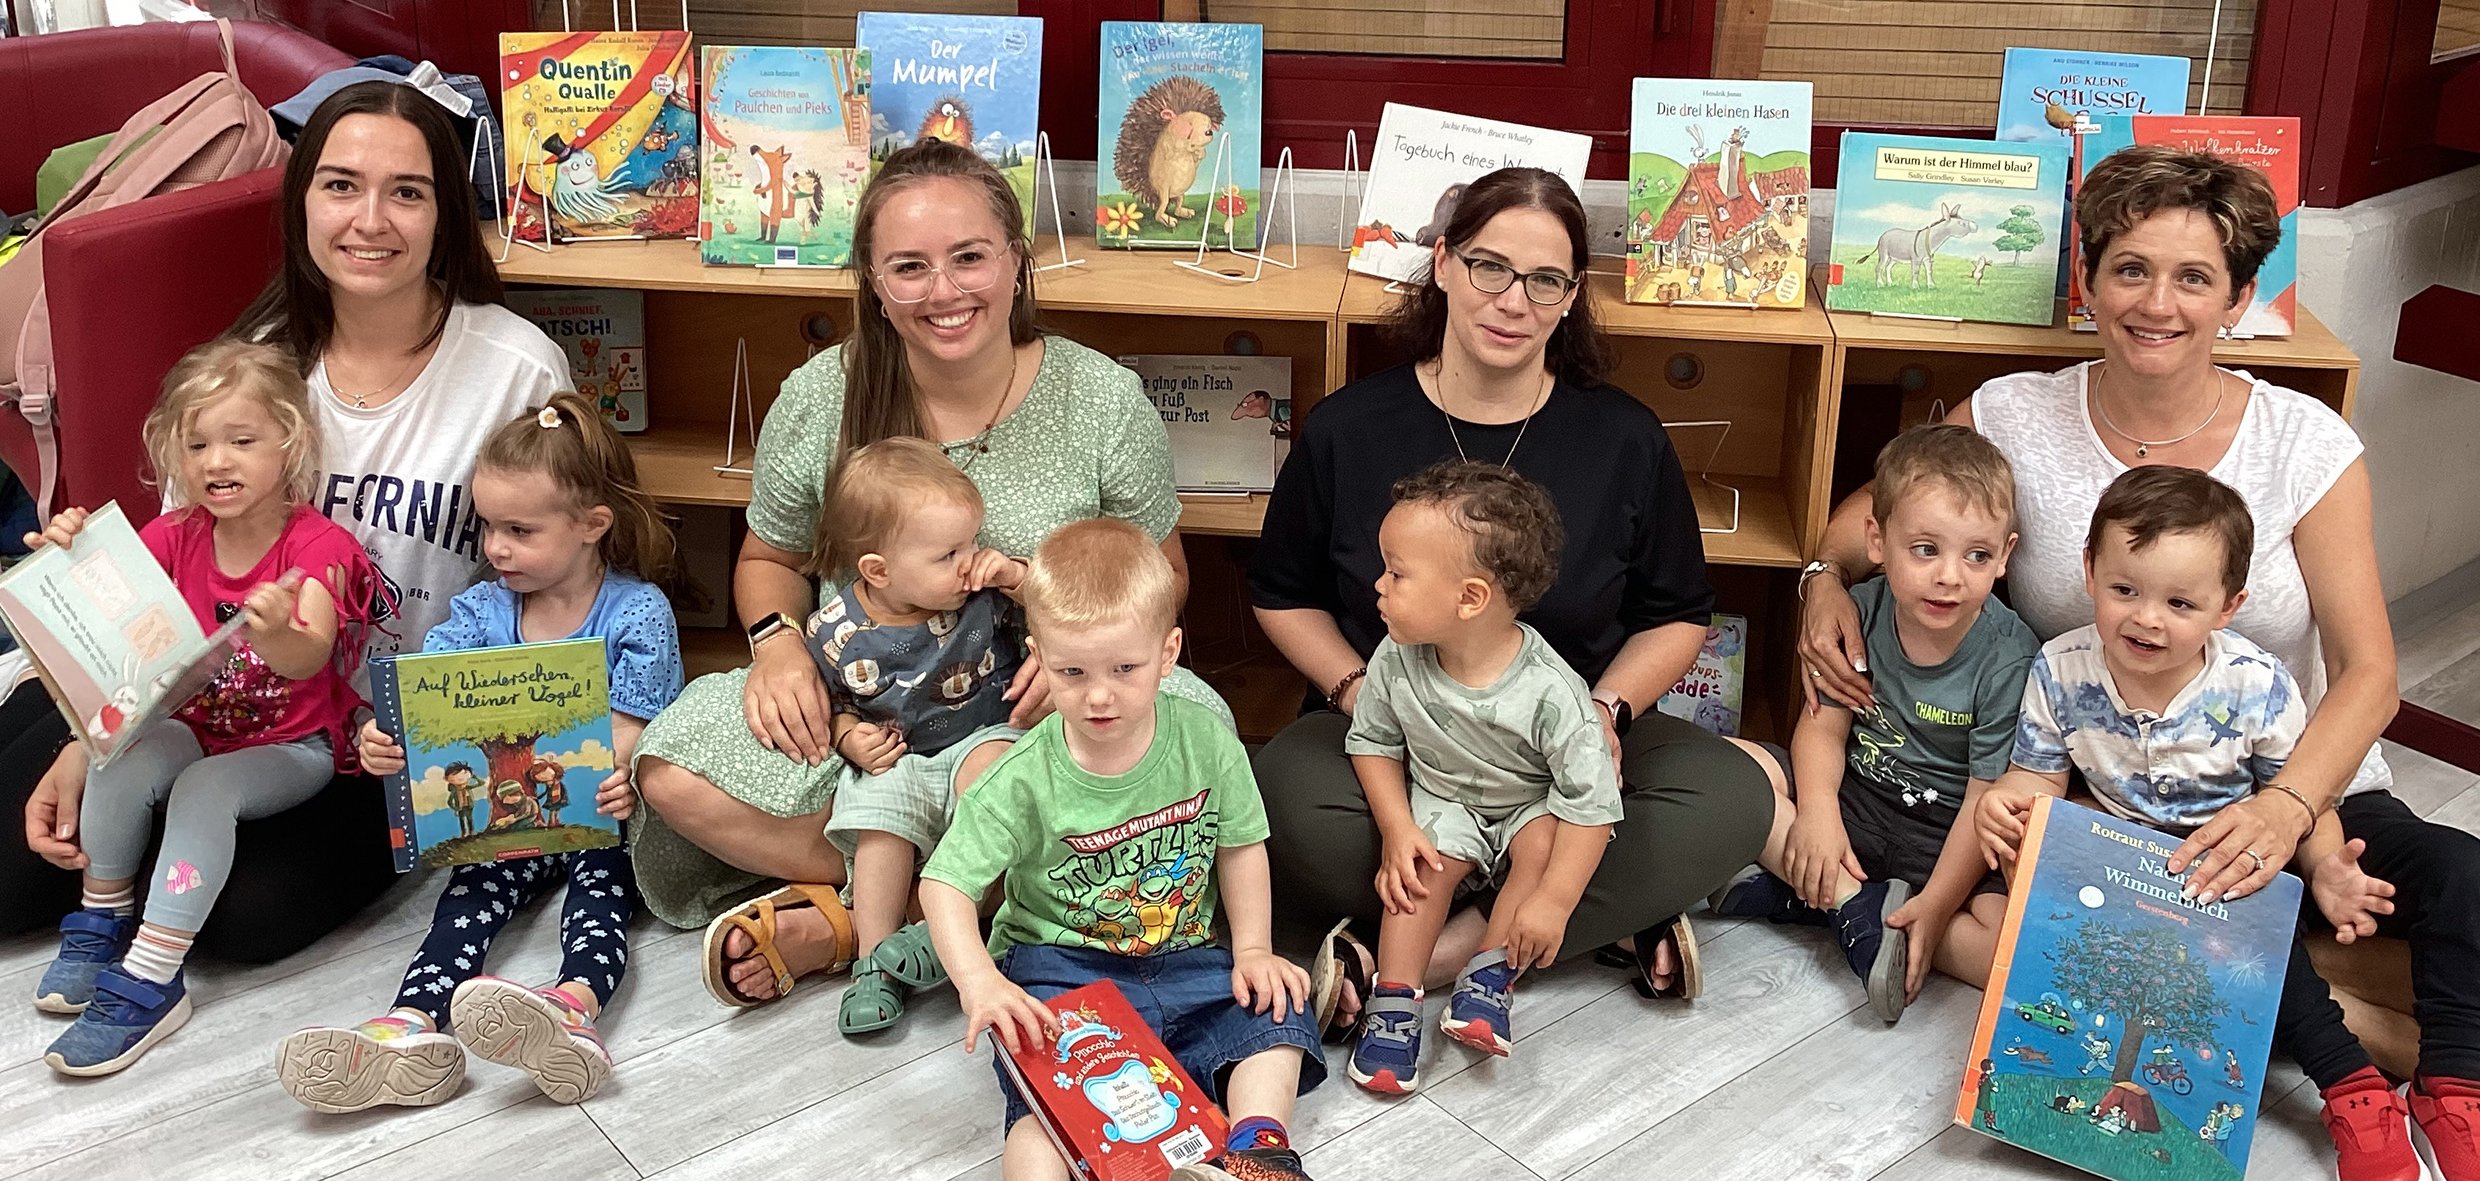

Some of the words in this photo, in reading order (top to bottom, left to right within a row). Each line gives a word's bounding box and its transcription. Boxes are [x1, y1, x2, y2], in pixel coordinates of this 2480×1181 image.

[931, 39, 962, 59] Der
[1112, 40, 1138, 58] Der
[1153, 50, 1188, 61] wissen
[540, 58, 632, 80] Quentin
[892, 57, 998, 93] Mumpel
[1170, 62, 1216, 73] Stacheln
[558, 83, 616, 100] Qualle
[2060, 75, 2080, 85] DIE
[2084, 76, 2129, 88] KLEINE
[748, 88, 796, 98] Geschichten
[2030, 86, 2153, 115] SCHUSSEL
[735, 100, 782, 113] Paulchen
[786, 104, 802, 114] und
[805, 101, 832, 114] Pieks
[1657, 102, 1676, 116] Die
[1680, 103, 1702, 117] drei
[1706, 103, 1750, 118] kleinen
[1753, 105, 1789, 119] Hasen
[1441, 120, 1461, 132] Jackie
[1461, 123, 1483, 135] French
[1488, 128, 1507, 139] Bruce
[1394, 134, 1455, 163] Tagebuch
[1462, 151, 1495, 169] eines
[1883, 153, 1921, 166] Warum
[1924, 156, 1936, 167] ist
[1939, 156, 1957, 168] der
[1960, 158, 2001, 171] Himmel
[2004, 160, 2033, 173] blau?
[1908, 172, 1924, 180] Sally
[1960, 175, 1980, 183] Susan
[1983, 176, 2005, 185] Varley
[1140, 375, 1149, 389] s
[1152, 376, 1177, 392] ging
[1181, 376, 1199, 390] ein
[1203, 374, 1233, 390] Fisch
[1162, 392, 1185, 408] Fuß
[1185, 408, 1210, 422] Post
[315, 472, 483, 563] FORNIA
[362, 544, 384, 561] ARY
[412, 673, 450, 698] Auf
[455, 662, 575, 690] Wiedersehen,
[453, 693, 521, 709] kleiner
[528, 679, 592, 708] Vogel!
[1915, 701, 1972, 726] CHAMELEON
[1069, 826, 1130, 850] TEENAGE
[1128, 808, 1173, 834] MUTANT
[2090, 821, 2145, 852] Rotraut
[1048, 812, 1218, 897] TURTLES
[2104, 865, 2230, 922] Wimmelbuch
[1072, 1039, 1116, 1063] Pinocchio
